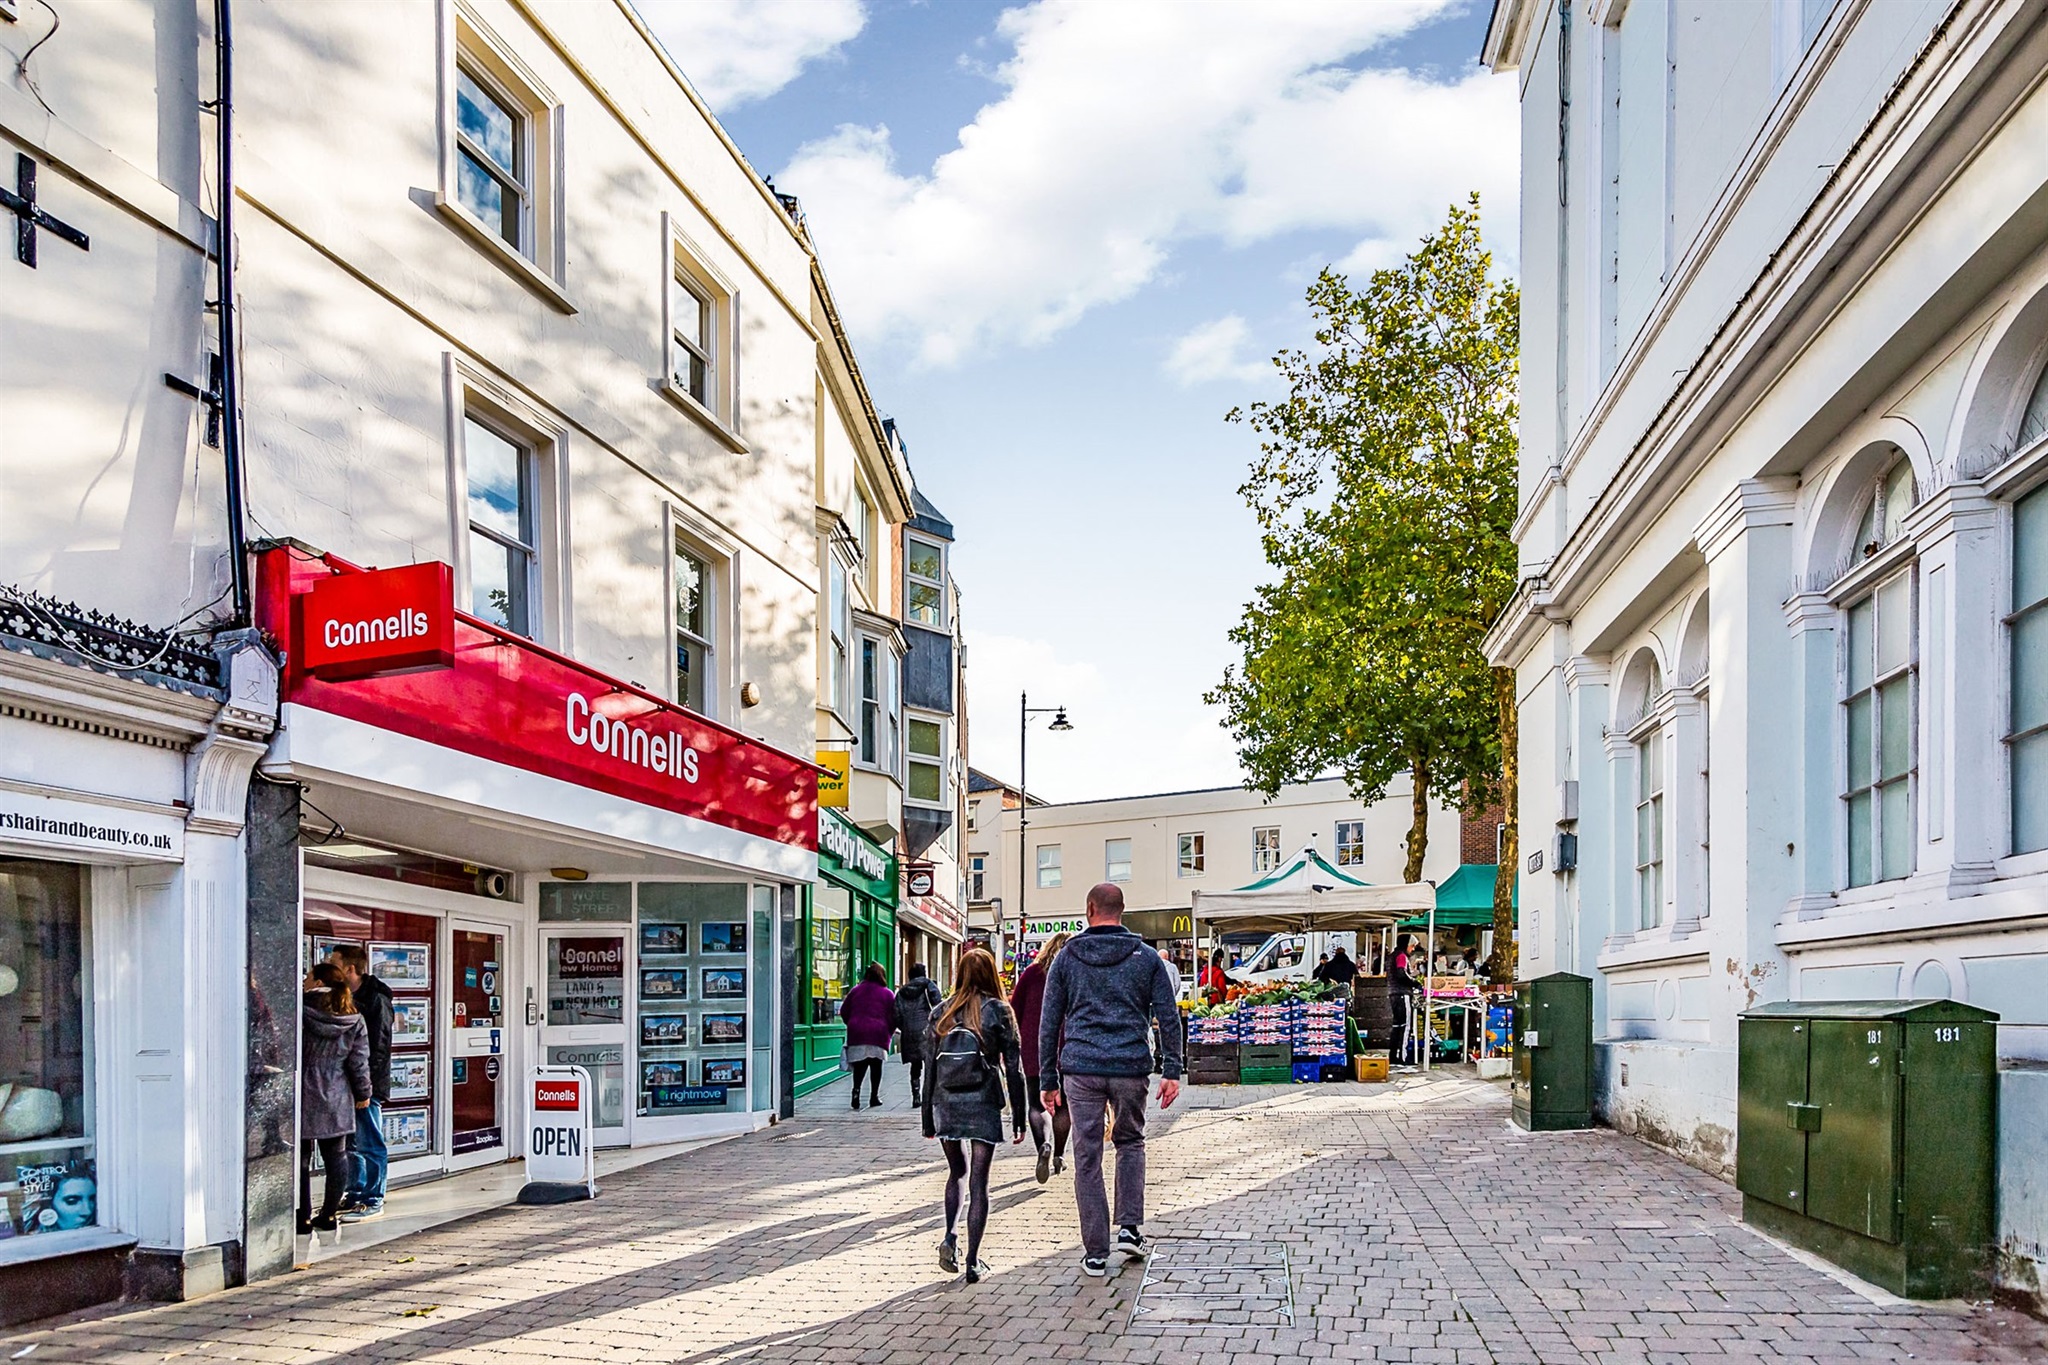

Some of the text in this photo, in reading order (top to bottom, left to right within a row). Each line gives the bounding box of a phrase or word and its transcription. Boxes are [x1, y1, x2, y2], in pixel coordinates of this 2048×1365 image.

[324, 607, 429, 649] Connells
[566, 692, 699, 784] Connells
[817, 782, 844, 790] wer
[818, 817, 886, 881] Paddy Power
[549, 890, 562, 914] 1
[560, 964, 618, 972] ew Homes
[566, 981, 594, 995] LAND
[1867, 1030, 1882, 1044] 181
[1934, 1027, 1960, 1042] 181
[538, 1089, 576, 1101] Connells
[670, 1090, 721, 1102] rightmove
[532, 1127, 581, 1156] OPEN
[21, 1165, 69, 1177] CONTROL
[24, 1176, 51, 1185] YOUR
[24, 1182, 55, 1194] STYLE!
